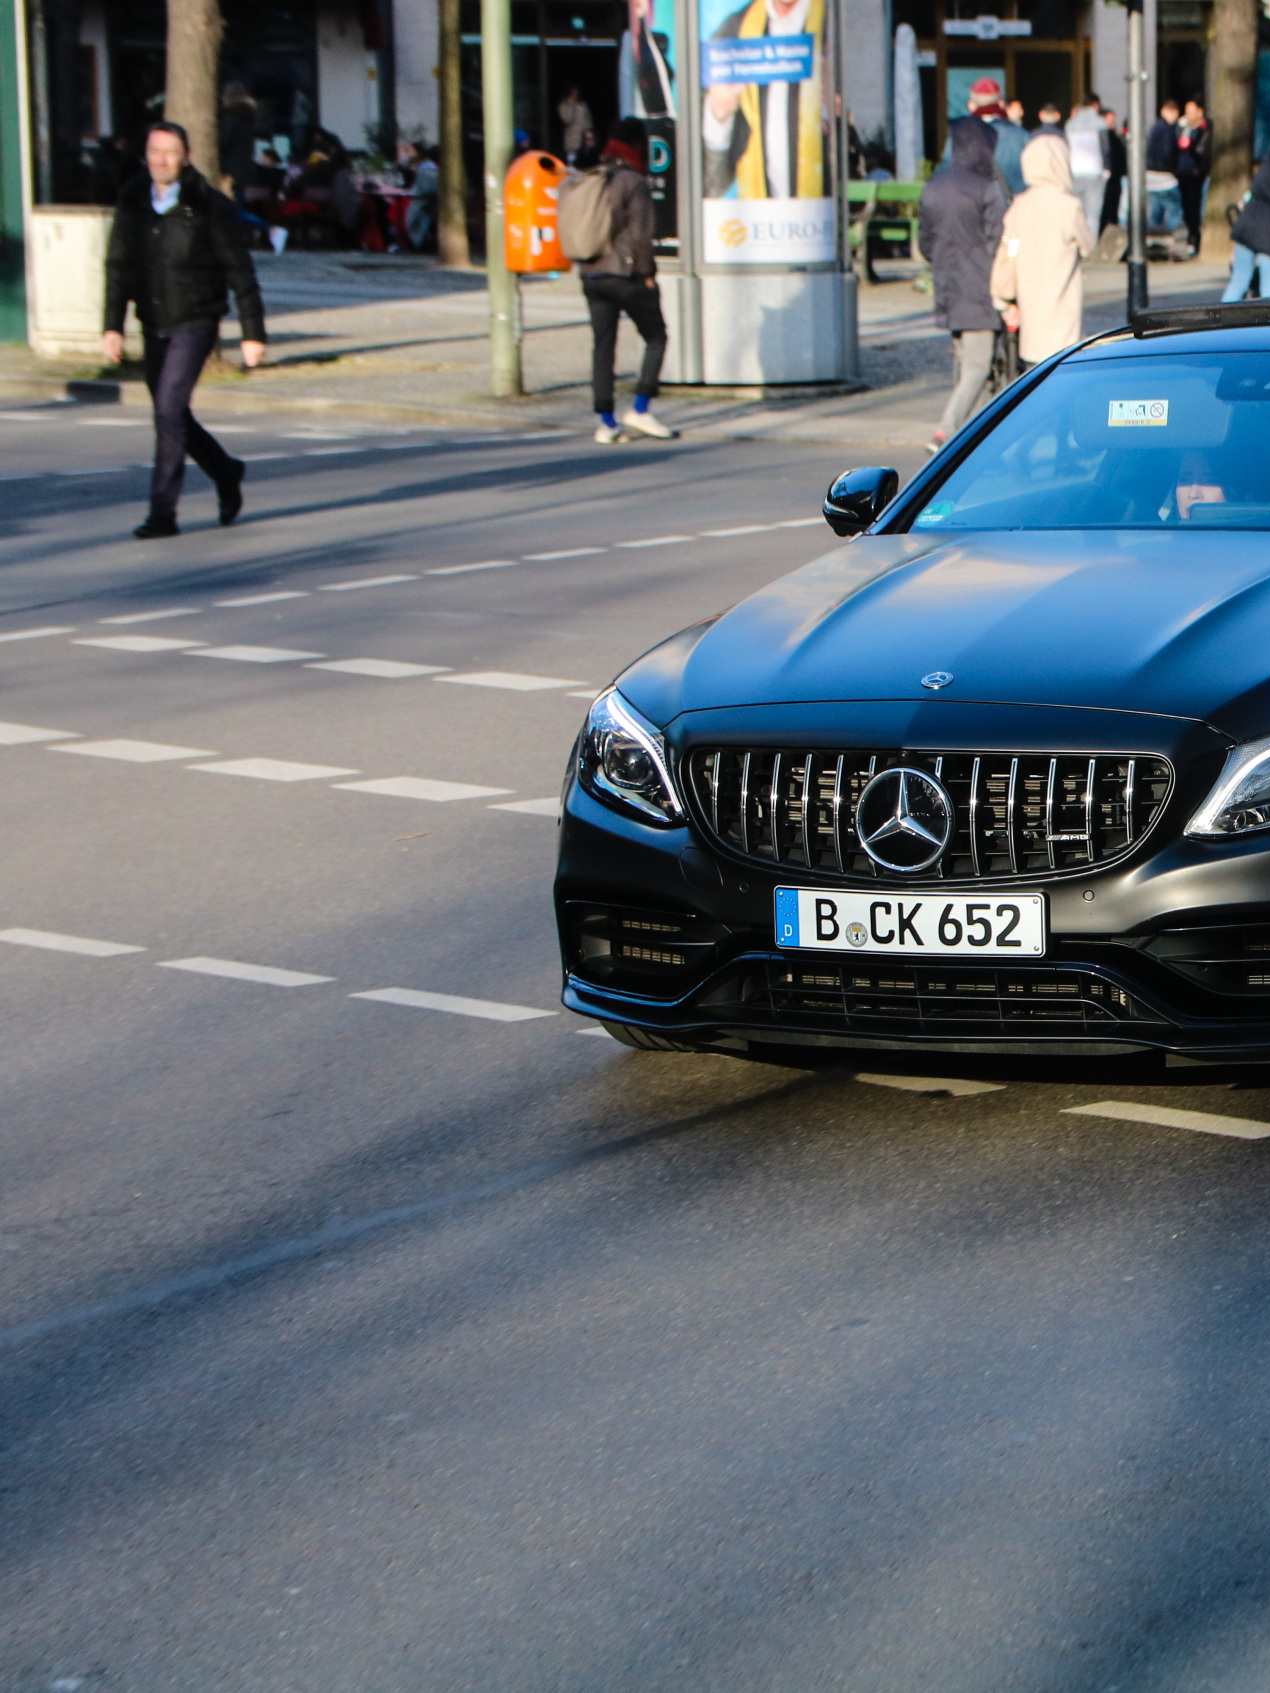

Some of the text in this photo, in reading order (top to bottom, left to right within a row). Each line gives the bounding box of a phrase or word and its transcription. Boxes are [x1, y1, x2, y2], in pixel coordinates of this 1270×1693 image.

[784, 924, 793, 937] D
[815, 898, 840, 941] B
[869, 901, 925, 946] CK
[938, 903, 1022, 947] 652
